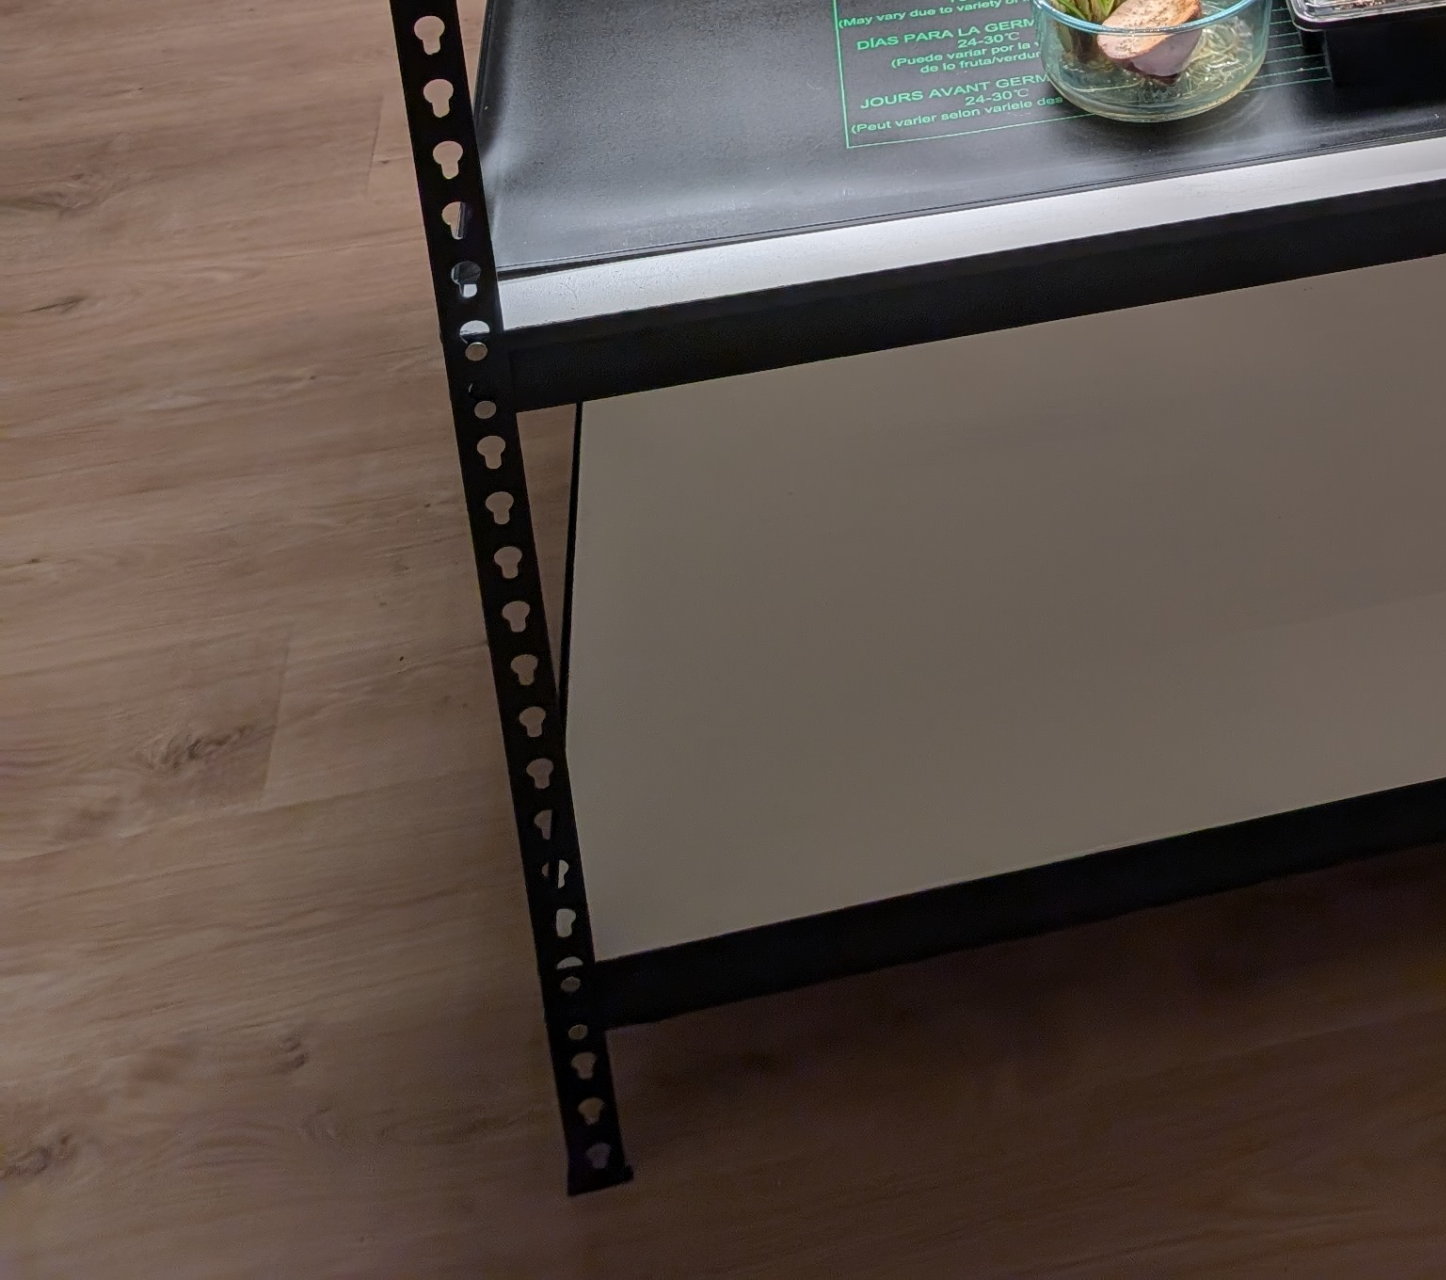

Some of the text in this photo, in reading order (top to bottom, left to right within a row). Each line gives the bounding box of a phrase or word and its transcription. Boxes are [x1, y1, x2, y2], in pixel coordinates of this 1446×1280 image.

[839, 16, 873, 28] (May
[876, 12, 906, 21] vary
[909, 8, 936, 17] due
[956, 0, 1001, 12] variety
[857, 18, 1036, 50] DÍAS PARA LA GERM
[891, 54, 943, 69] (Puede
[946, 48, 988, 60] variar
[991, 44, 1015, 55] por
[1018, 42, 1031, 50] la
[920, 65, 939, 73] de
[959, 51, 1041, 69] fruta/verdur
[860, 73, 1051, 109] JOURS AVANT GERM
[851, 121, 892, 134] (Peut
[895, 115, 937, 127] varier
[940, 108, 981, 121] selon
[1036, 96, 1064, 106] des
